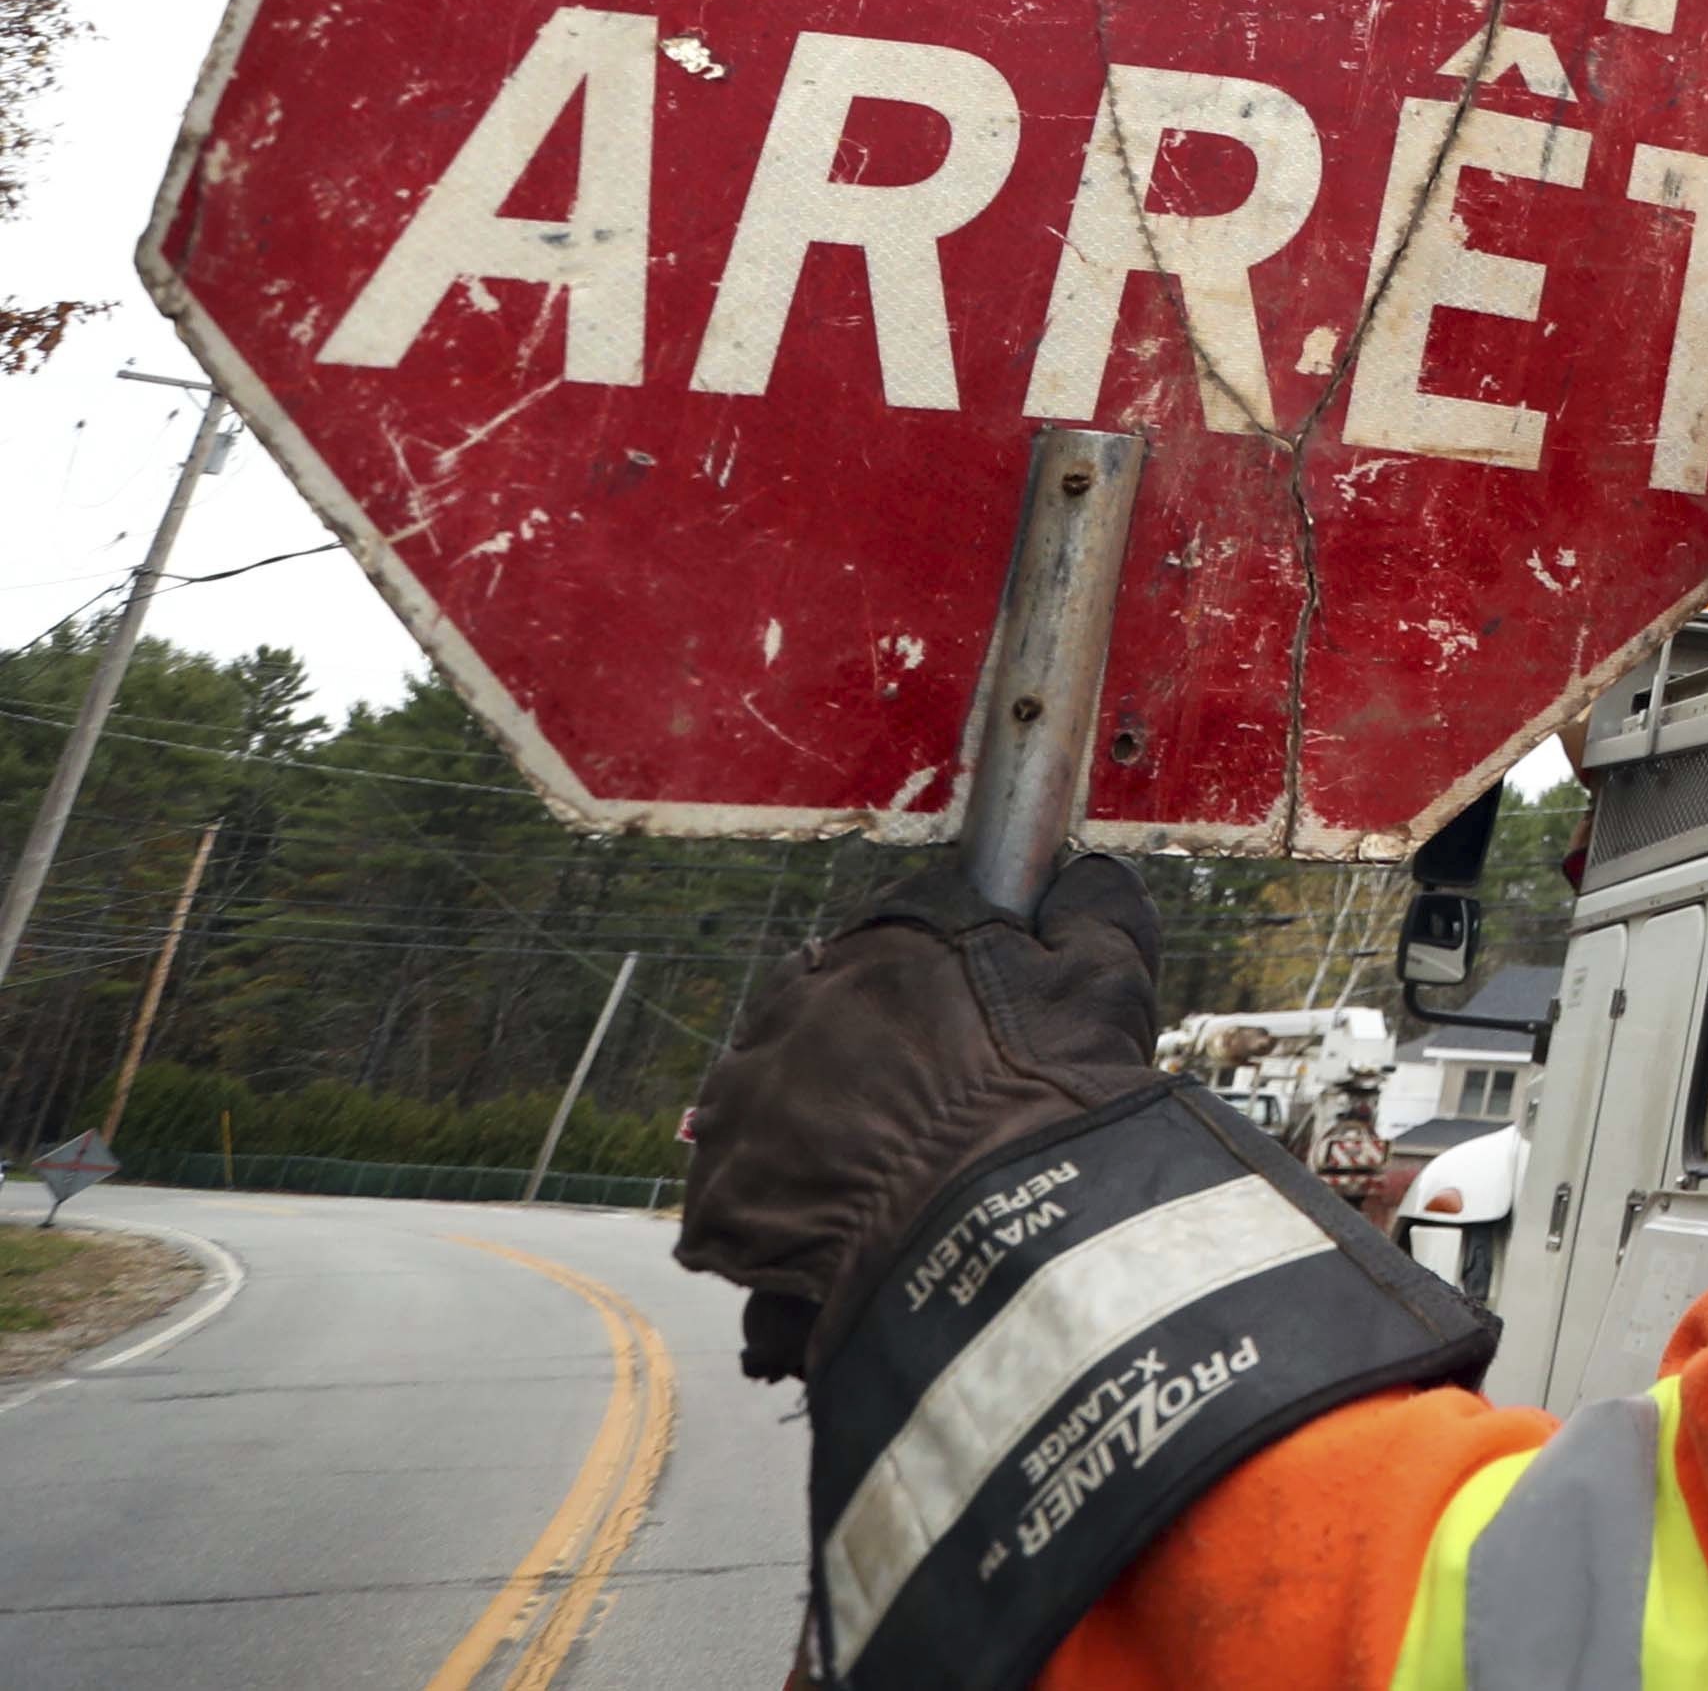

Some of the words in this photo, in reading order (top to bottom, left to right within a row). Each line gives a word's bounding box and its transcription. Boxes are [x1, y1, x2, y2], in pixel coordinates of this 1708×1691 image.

[904, 1160, 1080, 1312] REPELLENT
[948, 1200, 1067, 1307] WATER
[1020, 1347, 1167, 1486] X-LARGE
